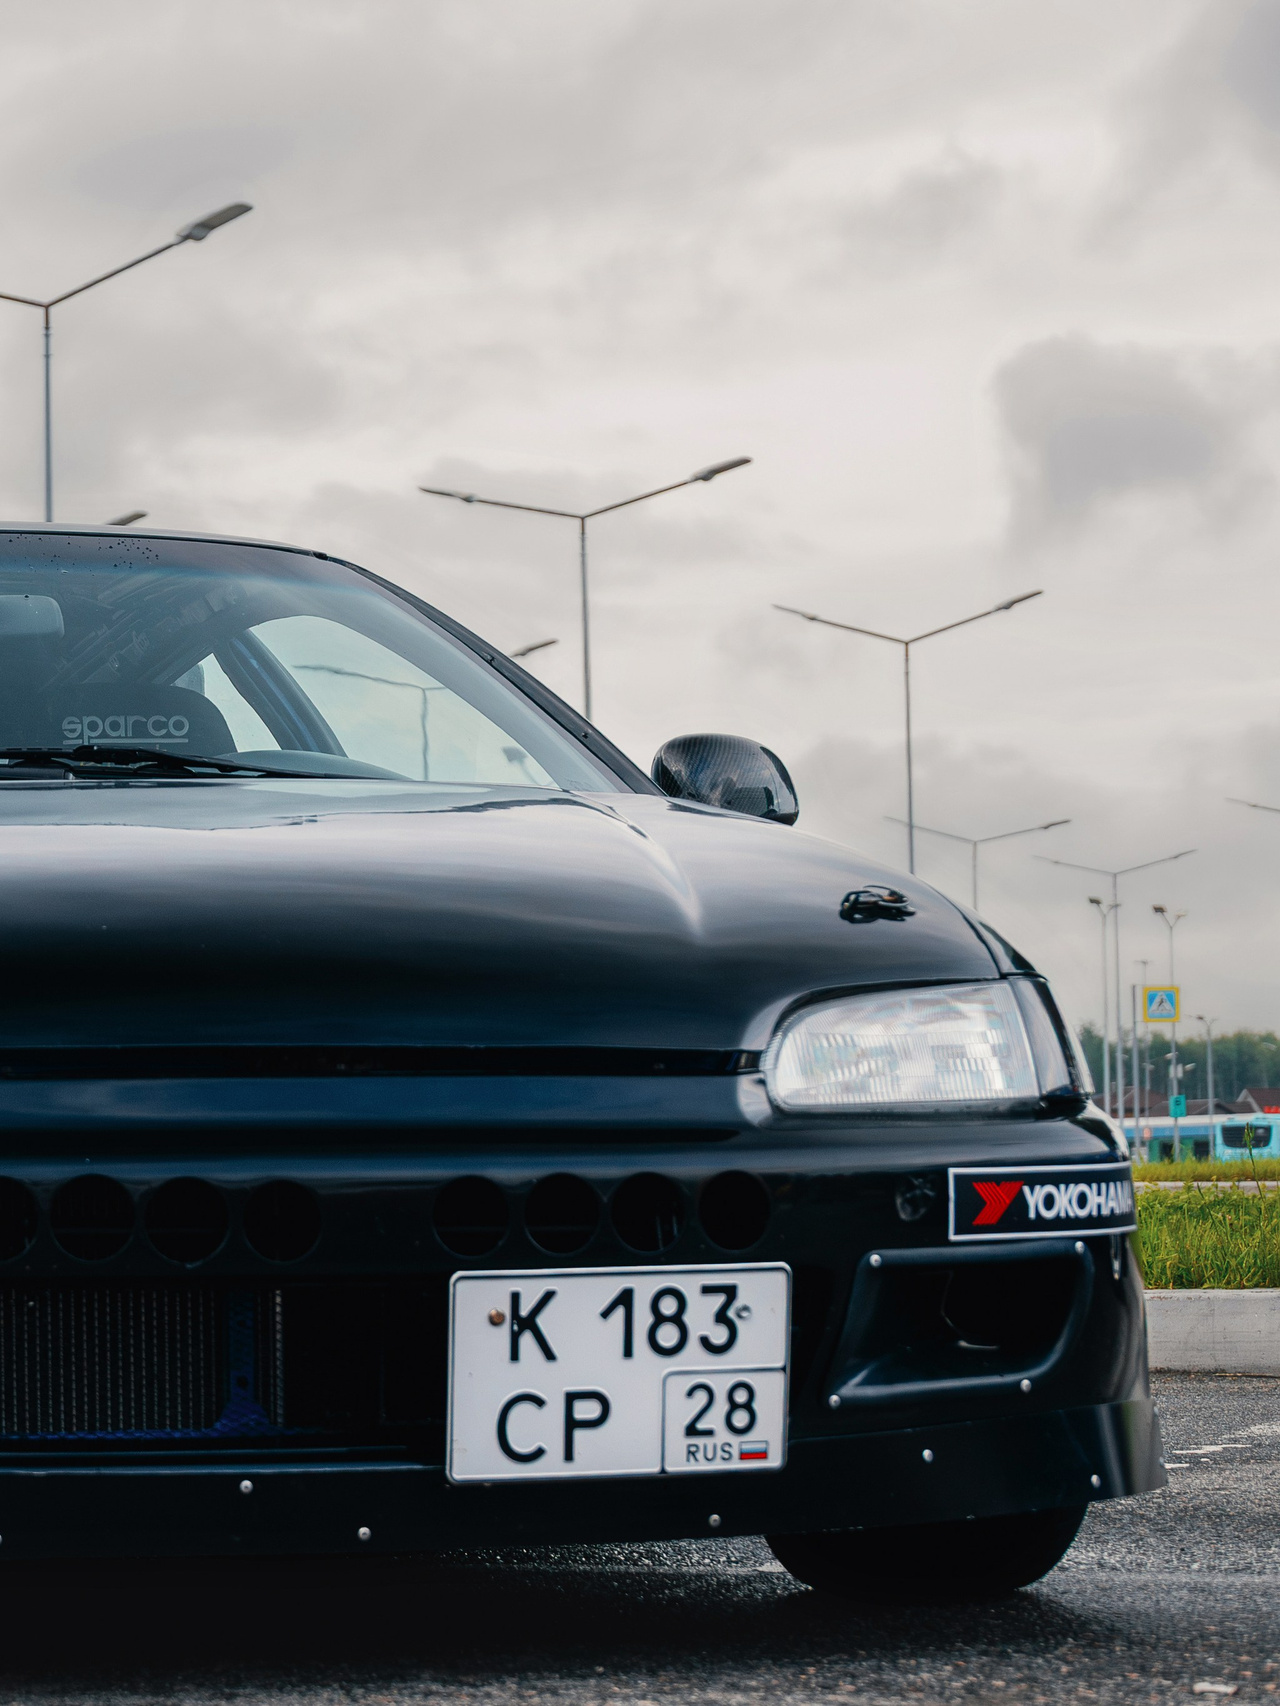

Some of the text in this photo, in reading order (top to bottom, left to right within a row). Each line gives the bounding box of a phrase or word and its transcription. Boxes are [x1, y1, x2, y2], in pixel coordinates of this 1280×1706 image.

[62, 715, 190, 747] sparco
[510, 1284, 739, 1362] К 183
[684, 1382, 757, 1437] 28
[686, 1442, 733, 1462] RUS
